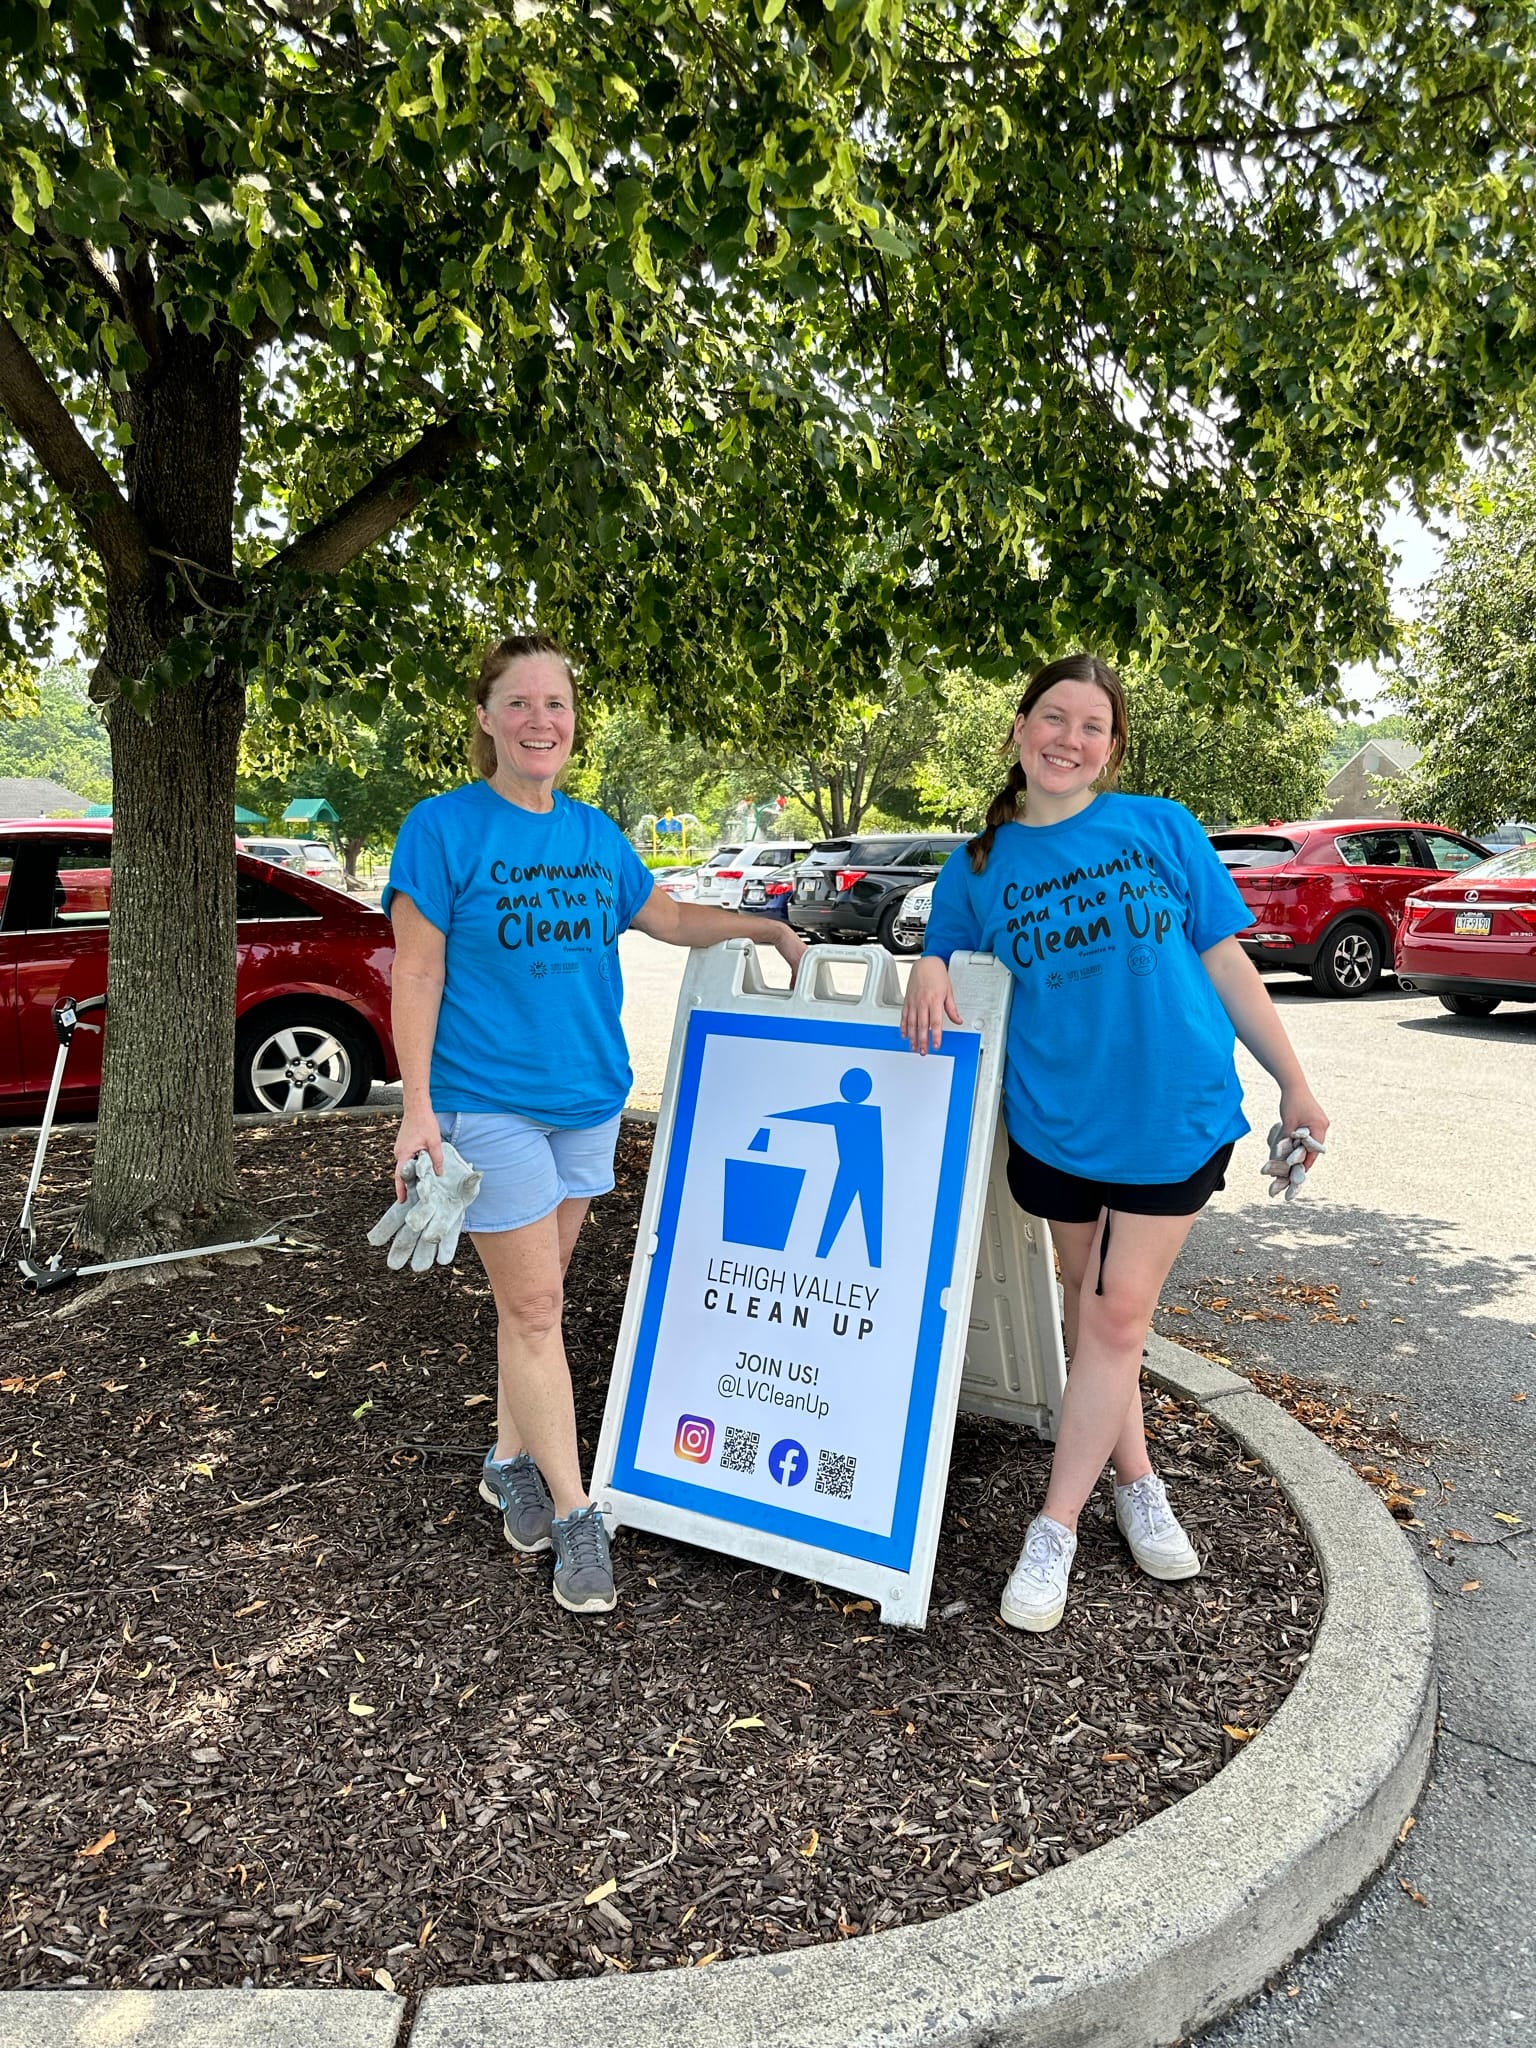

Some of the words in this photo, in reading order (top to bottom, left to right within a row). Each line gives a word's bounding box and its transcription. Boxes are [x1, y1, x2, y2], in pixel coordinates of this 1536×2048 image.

[490, 857, 613, 887] Community
[1003, 849, 1158, 910] Community
[496, 892, 542, 911] and
[546, 888, 588, 909] The
[595, 888, 614, 910] Ar
[1006, 907, 1050, 932] and
[1059, 891, 1106, 916] The
[1119, 881, 1168, 902] Arts
[498, 911, 591, 950] Clean
[1012, 916, 1111, 968] Clean
[1125, 902, 1171, 944] Up
[707, 1258, 786, 1294] LEHIGH
[794, 1273, 879, 1311] VALLEY
[704, 1289, 809, 1328] CLEAN
[833, 1313, 873, 1340] UP
[736, 1352, 782, 1378] JOIN
[788, 1362, 819, 1386] US!
[718, 1374, 829, 1419] @LVCleanUp
